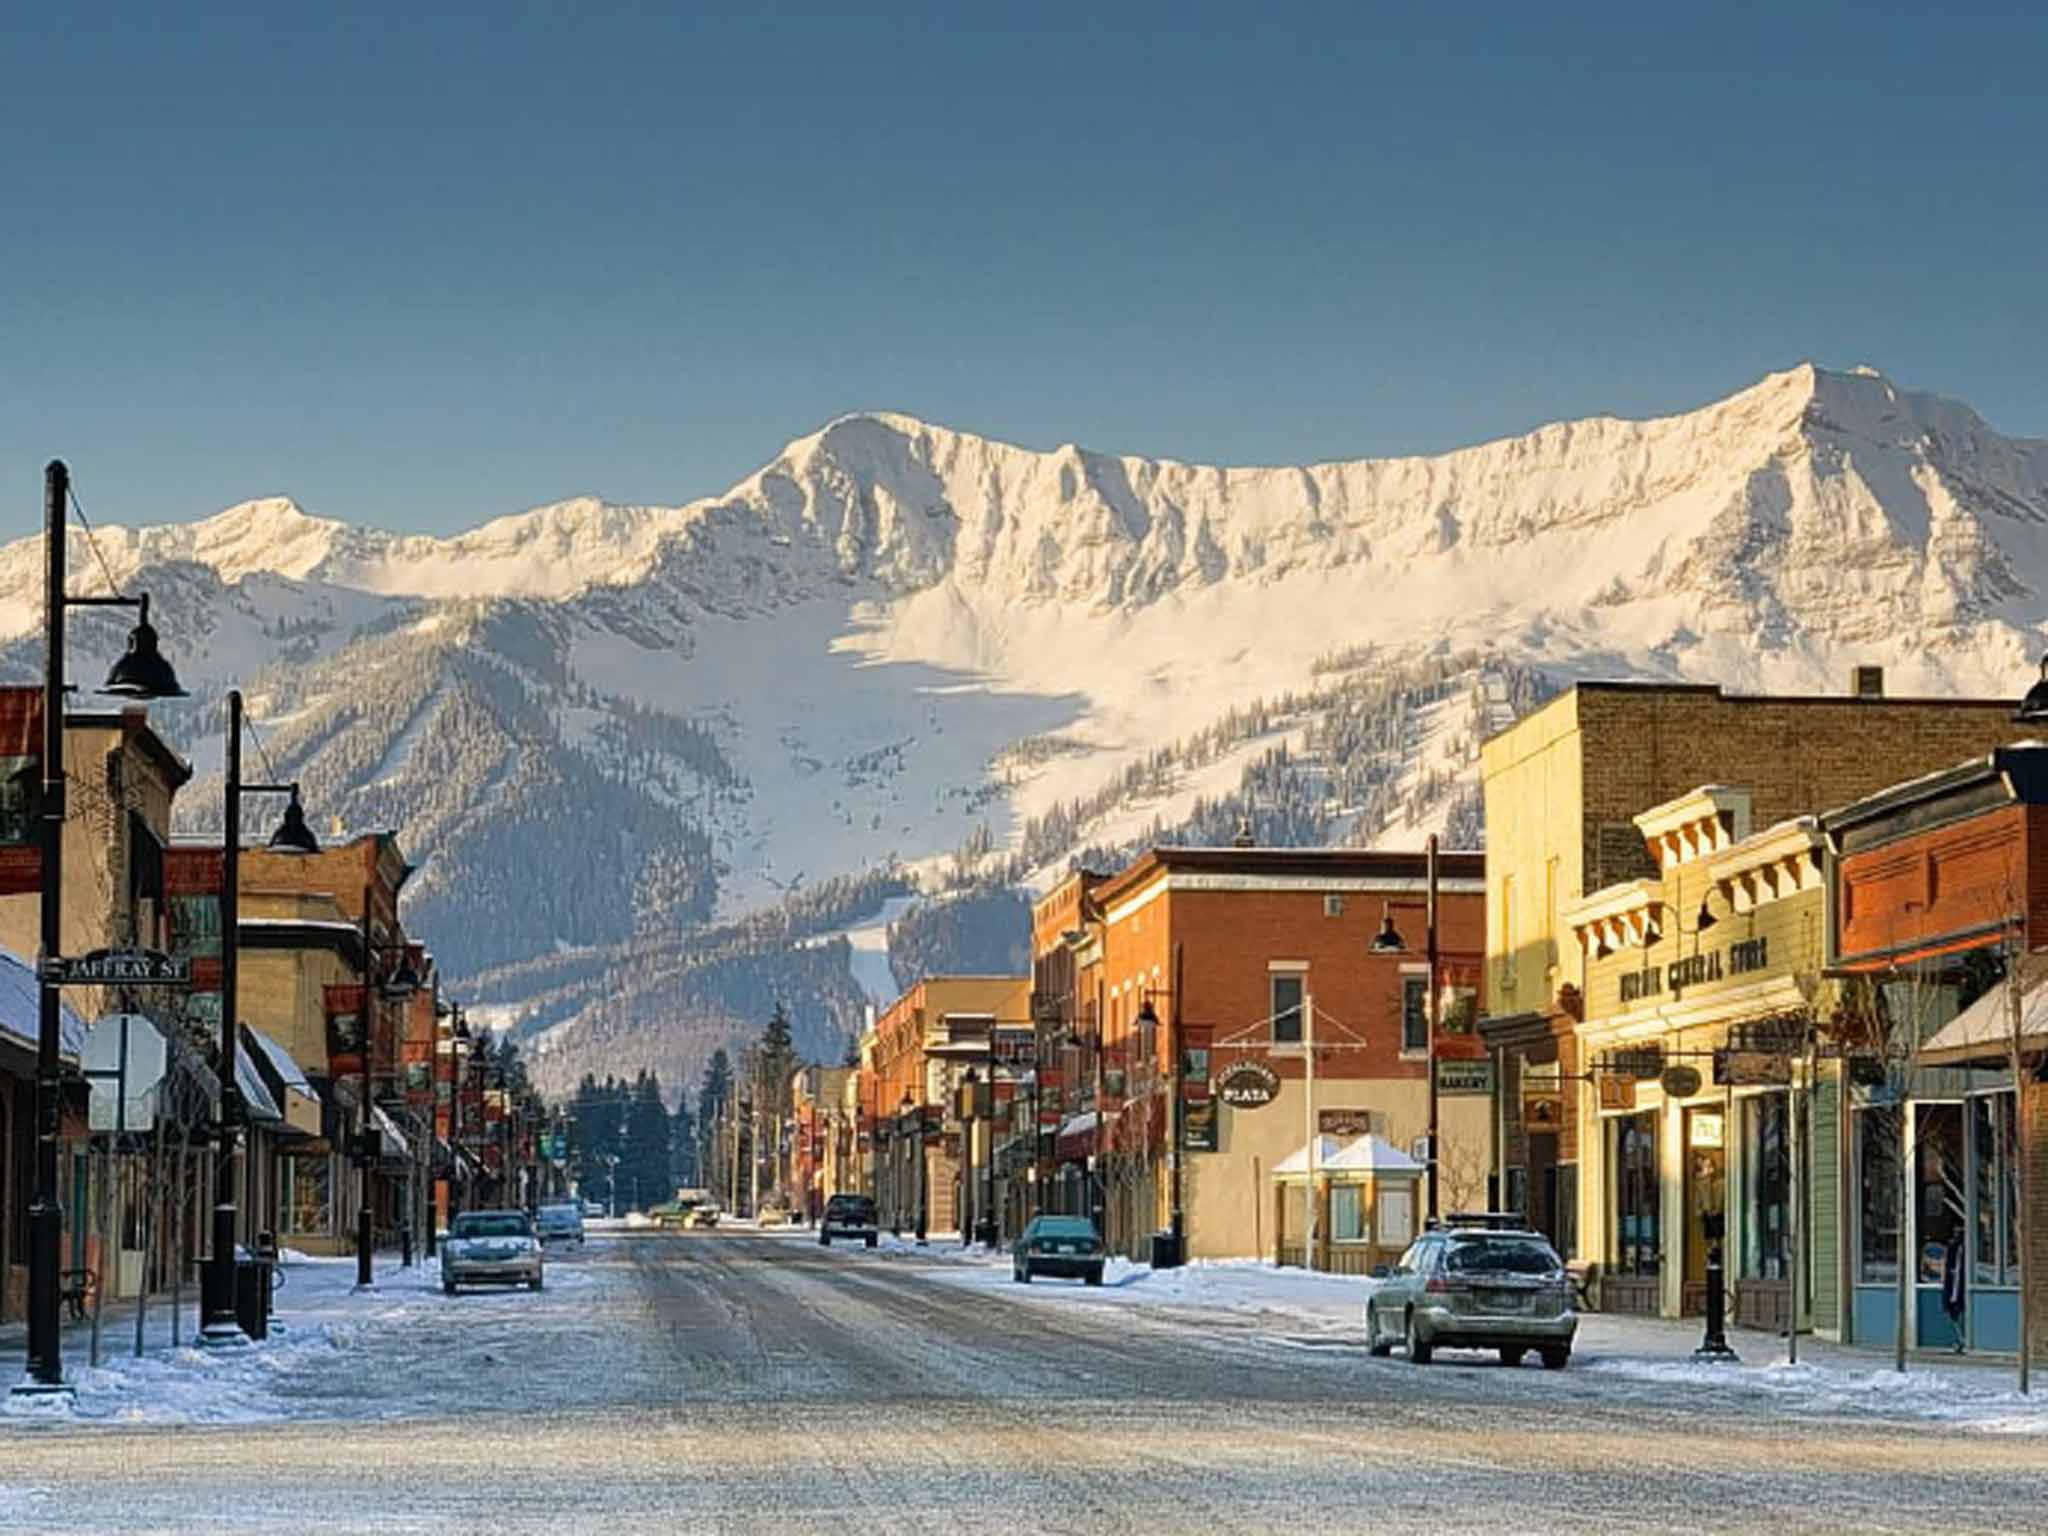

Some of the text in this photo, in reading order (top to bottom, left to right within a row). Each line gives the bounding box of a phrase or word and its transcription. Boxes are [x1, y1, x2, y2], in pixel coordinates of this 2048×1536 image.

[69, 960, 180, 977] JAFFRAY ST
[1439, 1075, 1489, 1089] BAKERY
[1223, 1089, 1270, 1101] PLAZA
